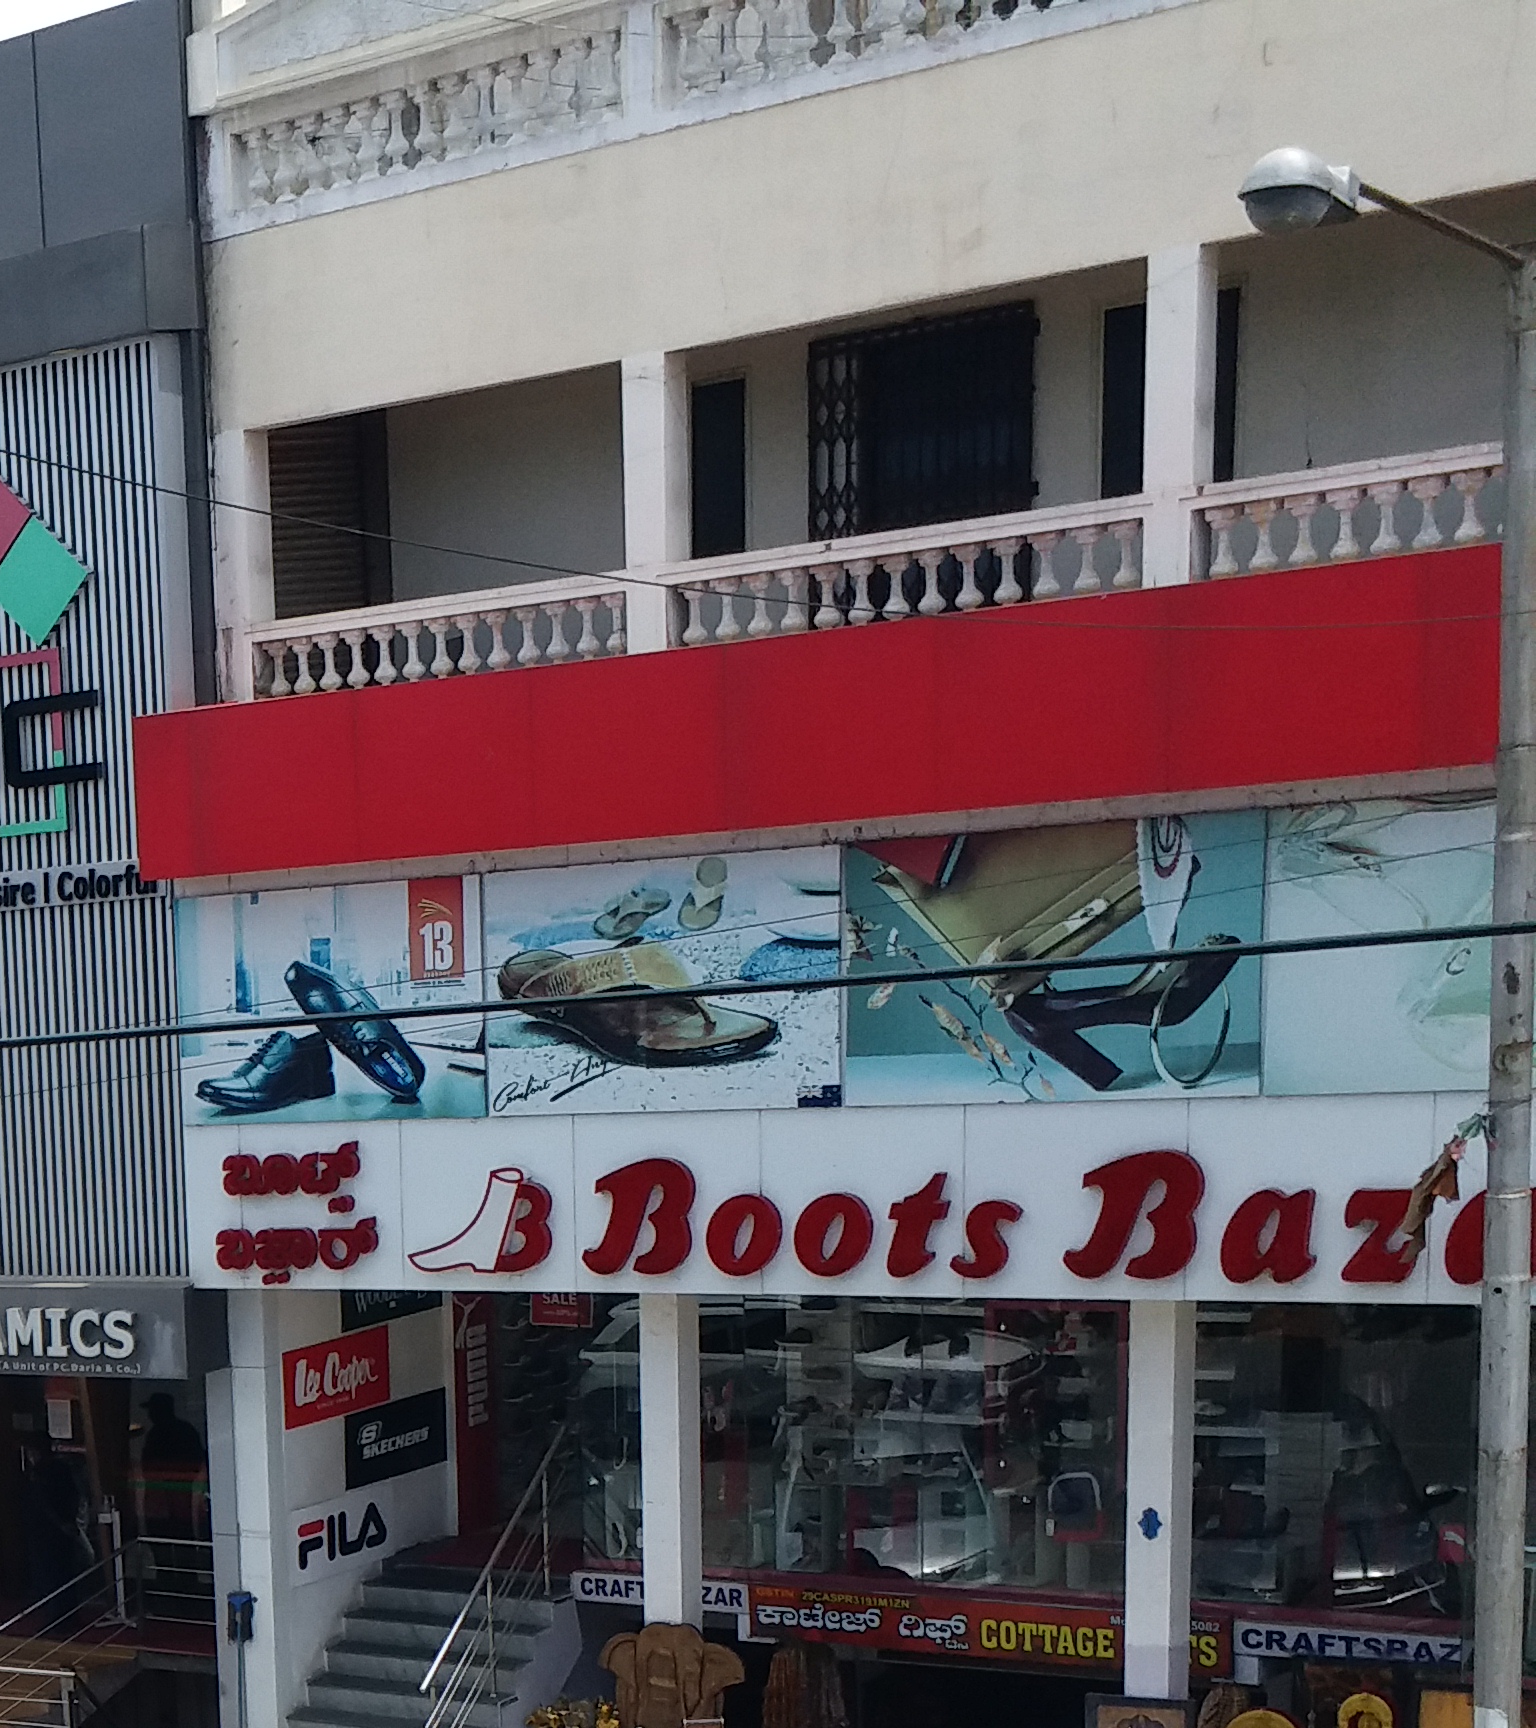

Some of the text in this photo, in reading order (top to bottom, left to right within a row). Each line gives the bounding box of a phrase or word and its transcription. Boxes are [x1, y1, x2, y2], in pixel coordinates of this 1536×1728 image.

[418, 920, 454, 971] 13
[582, 1157, 1024, 1279] Boots
[12, 1361, 37, 1372] Unit
[295, 1351, 379, 1408] Lee Cooper
[362, 1426, 430, 1460] SKECHERS
[297, 1501, 388, 1571] FILA
[980, 1619, 1116, 1659] COTTAGE
